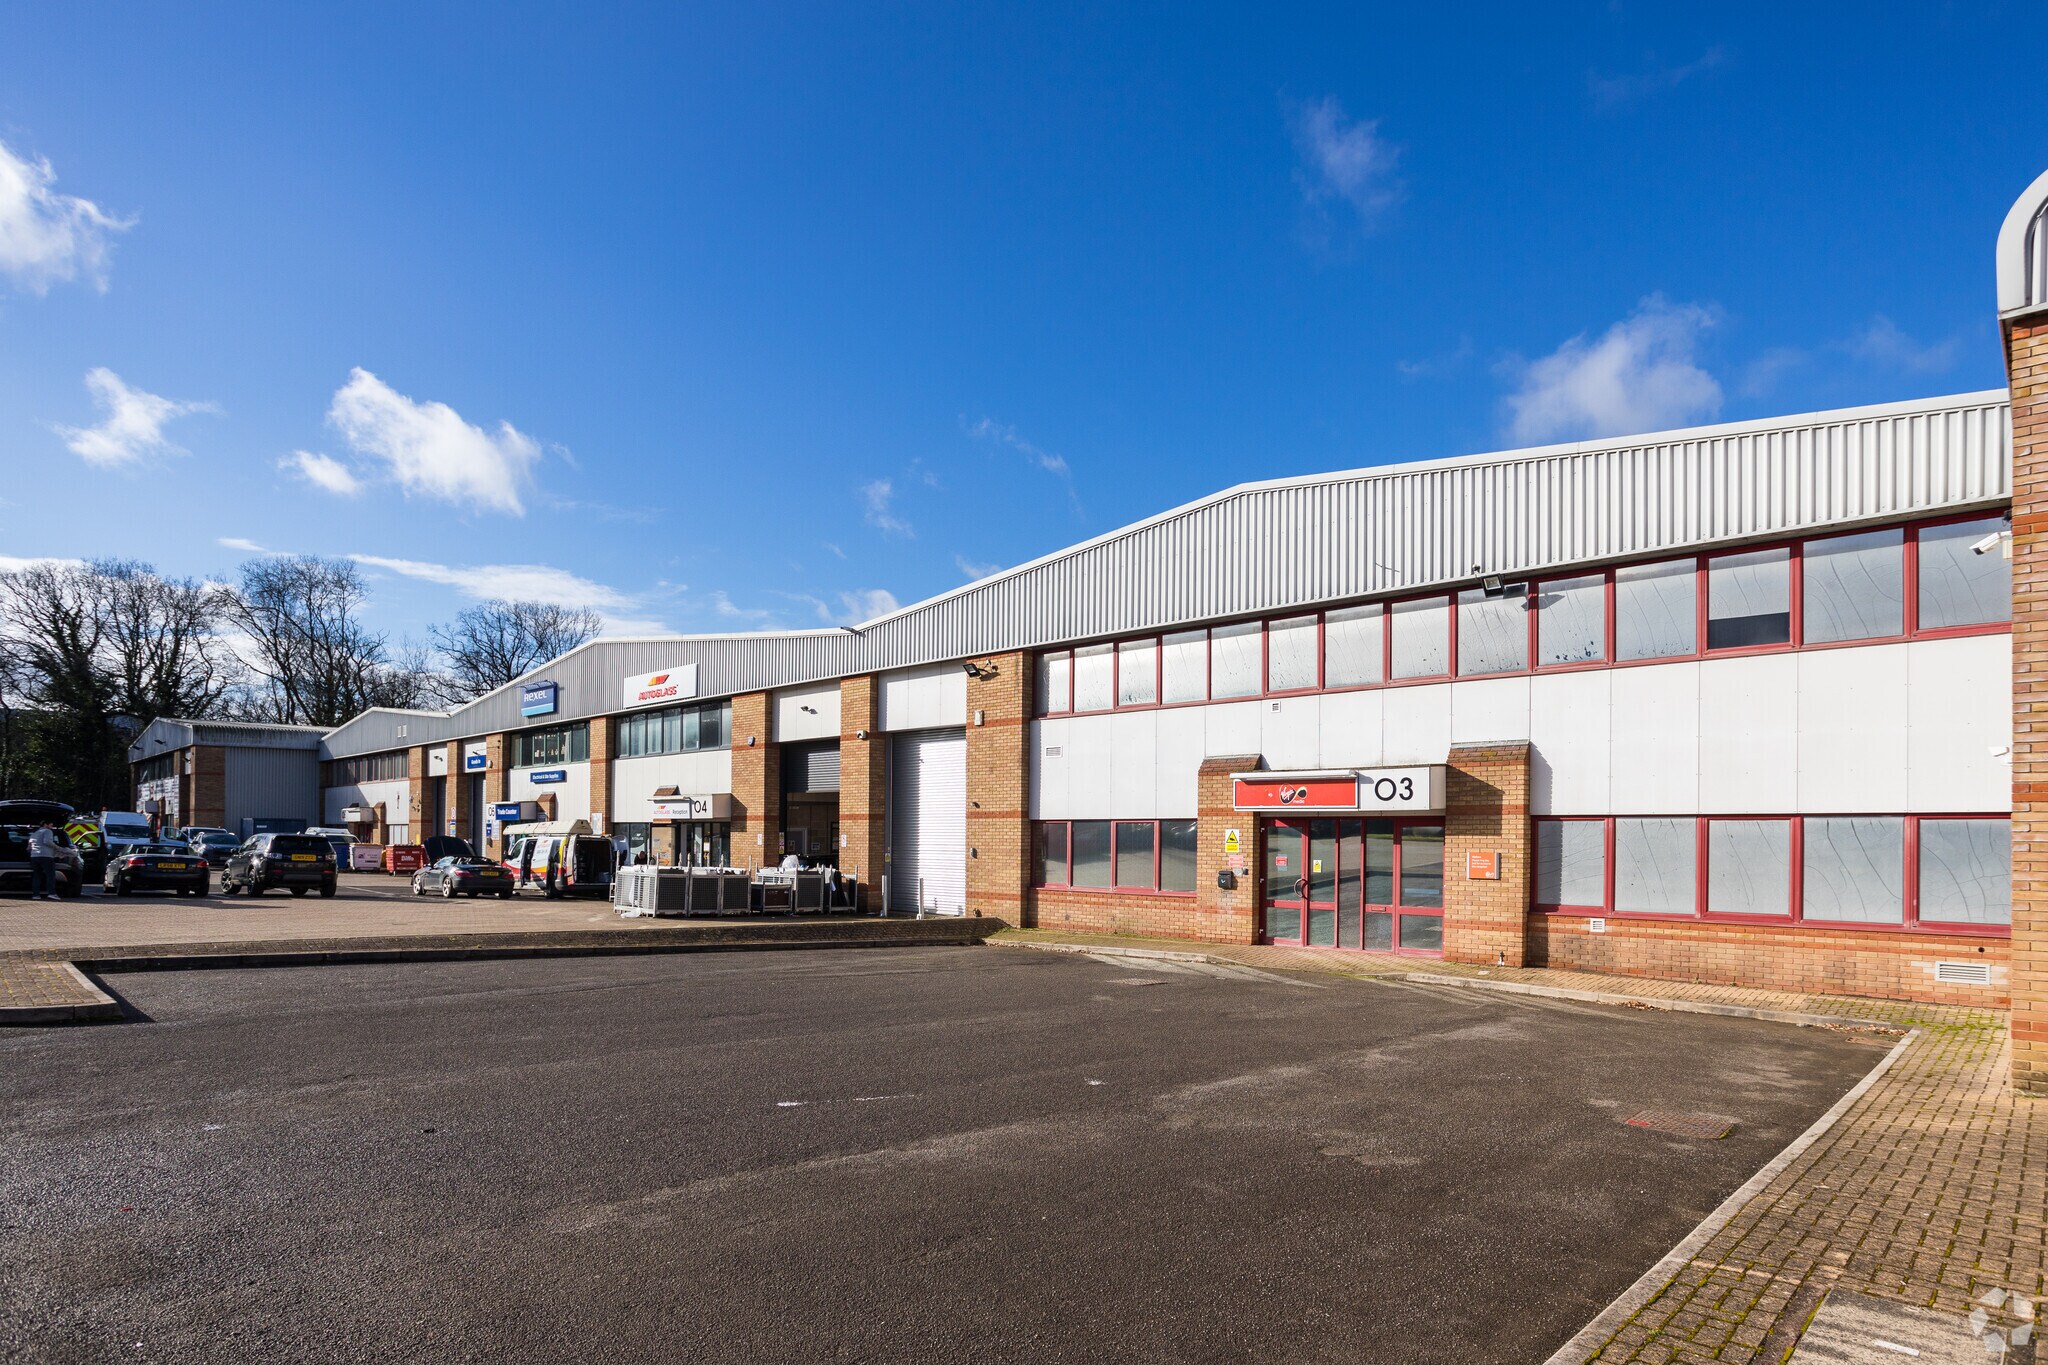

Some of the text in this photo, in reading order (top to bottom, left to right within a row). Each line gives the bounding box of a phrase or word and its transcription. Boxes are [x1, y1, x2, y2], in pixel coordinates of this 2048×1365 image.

[638, 686, 677, 700] AUTOGLASS
[1375, 777, 1414, 801] 03
[694, 800, 707, 813] 04
